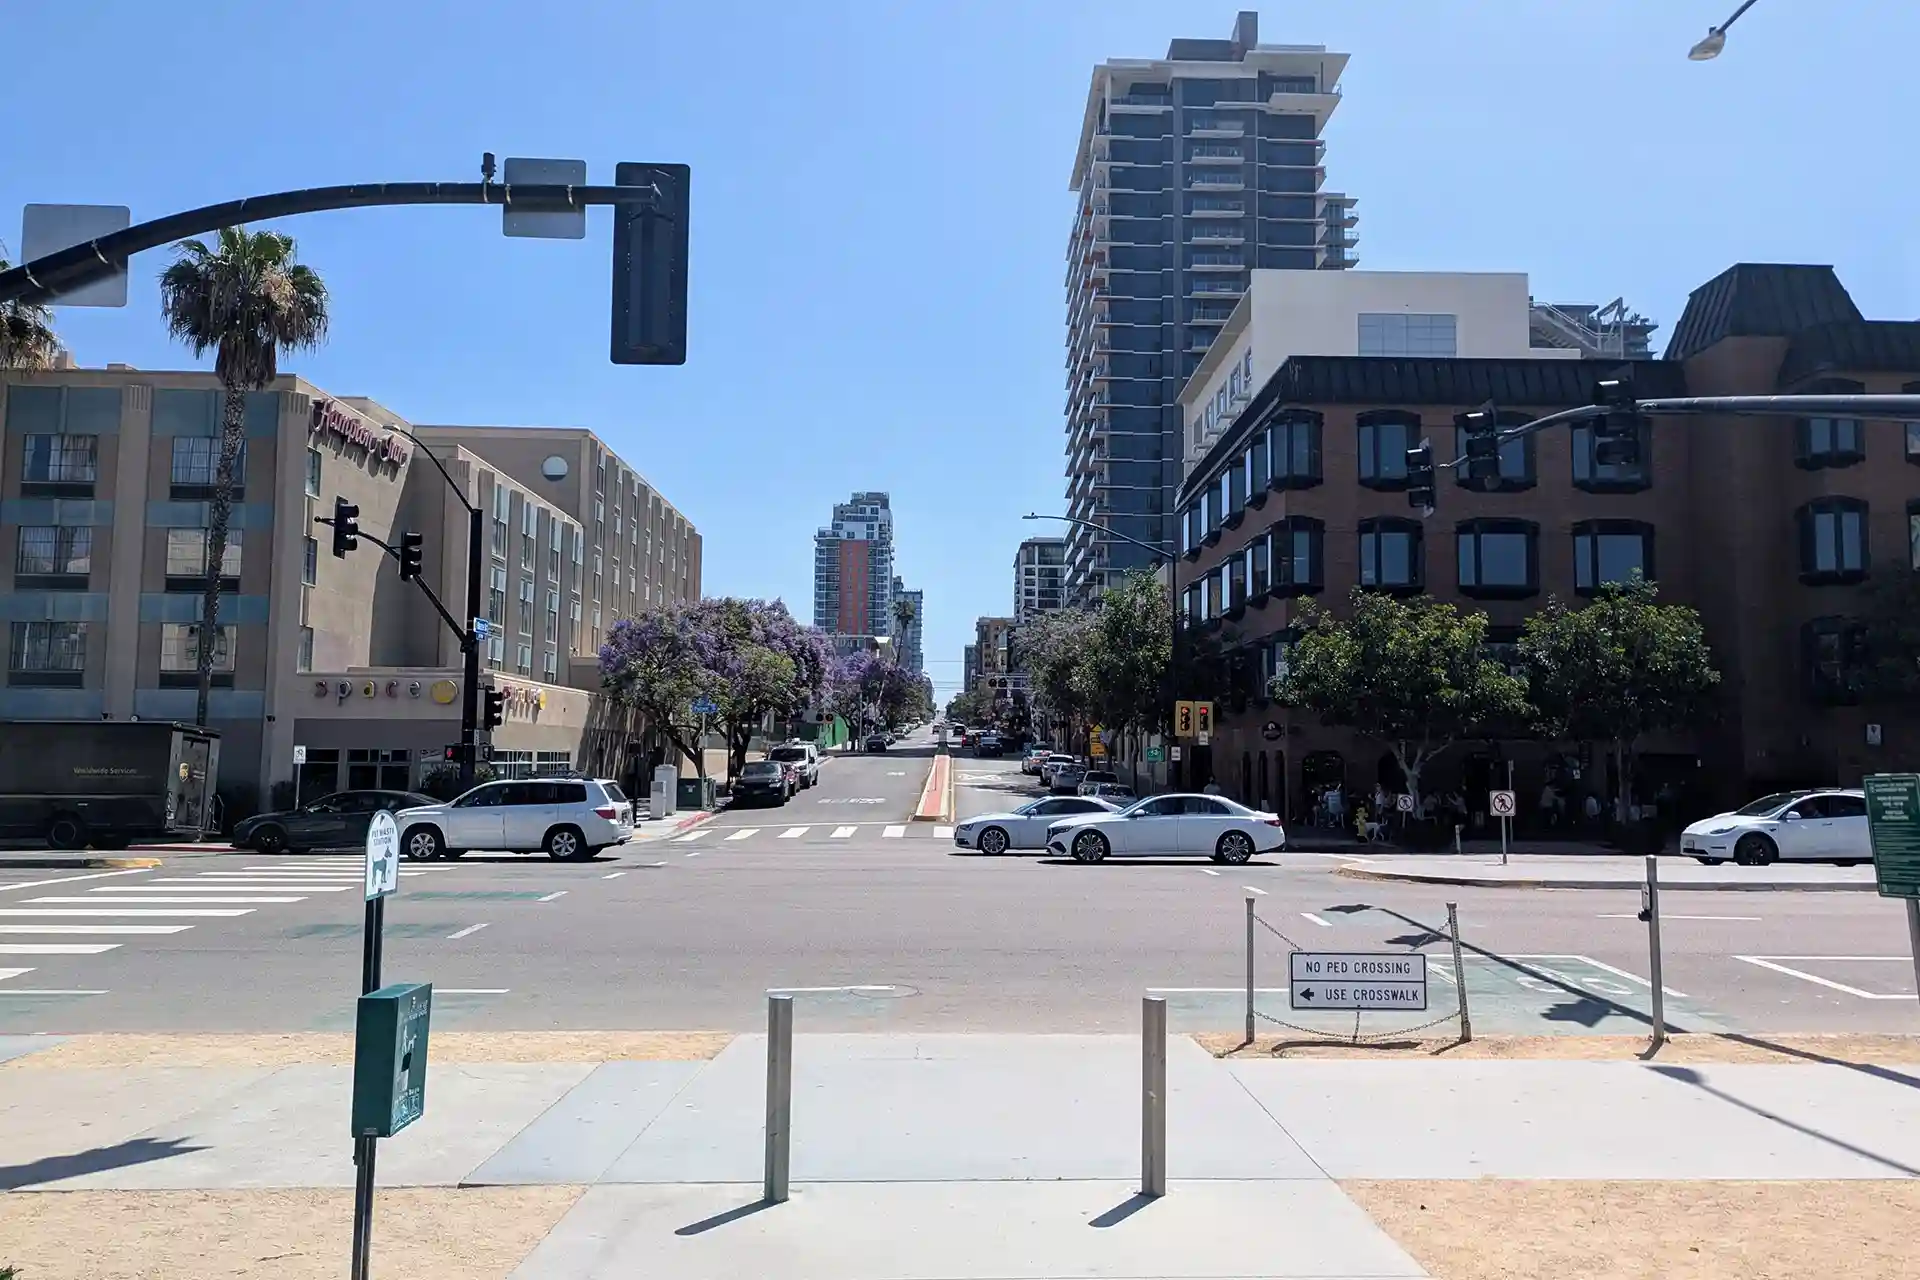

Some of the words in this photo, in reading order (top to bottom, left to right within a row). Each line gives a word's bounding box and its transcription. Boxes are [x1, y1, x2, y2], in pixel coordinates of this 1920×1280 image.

[310, 400, 378, 453] Hampton
[379, 434, 408, 467] Inn
[314, 680, 421, 706] space
[1306, 961, 1320, 973] NO
[1327, 961, 1348, 973] PED
[1354, 962, 1411, 974] CROSSING
[1325, 988, 1347, 1000] USE
[1353, 989, 1419, 1001] CROSSWALK
